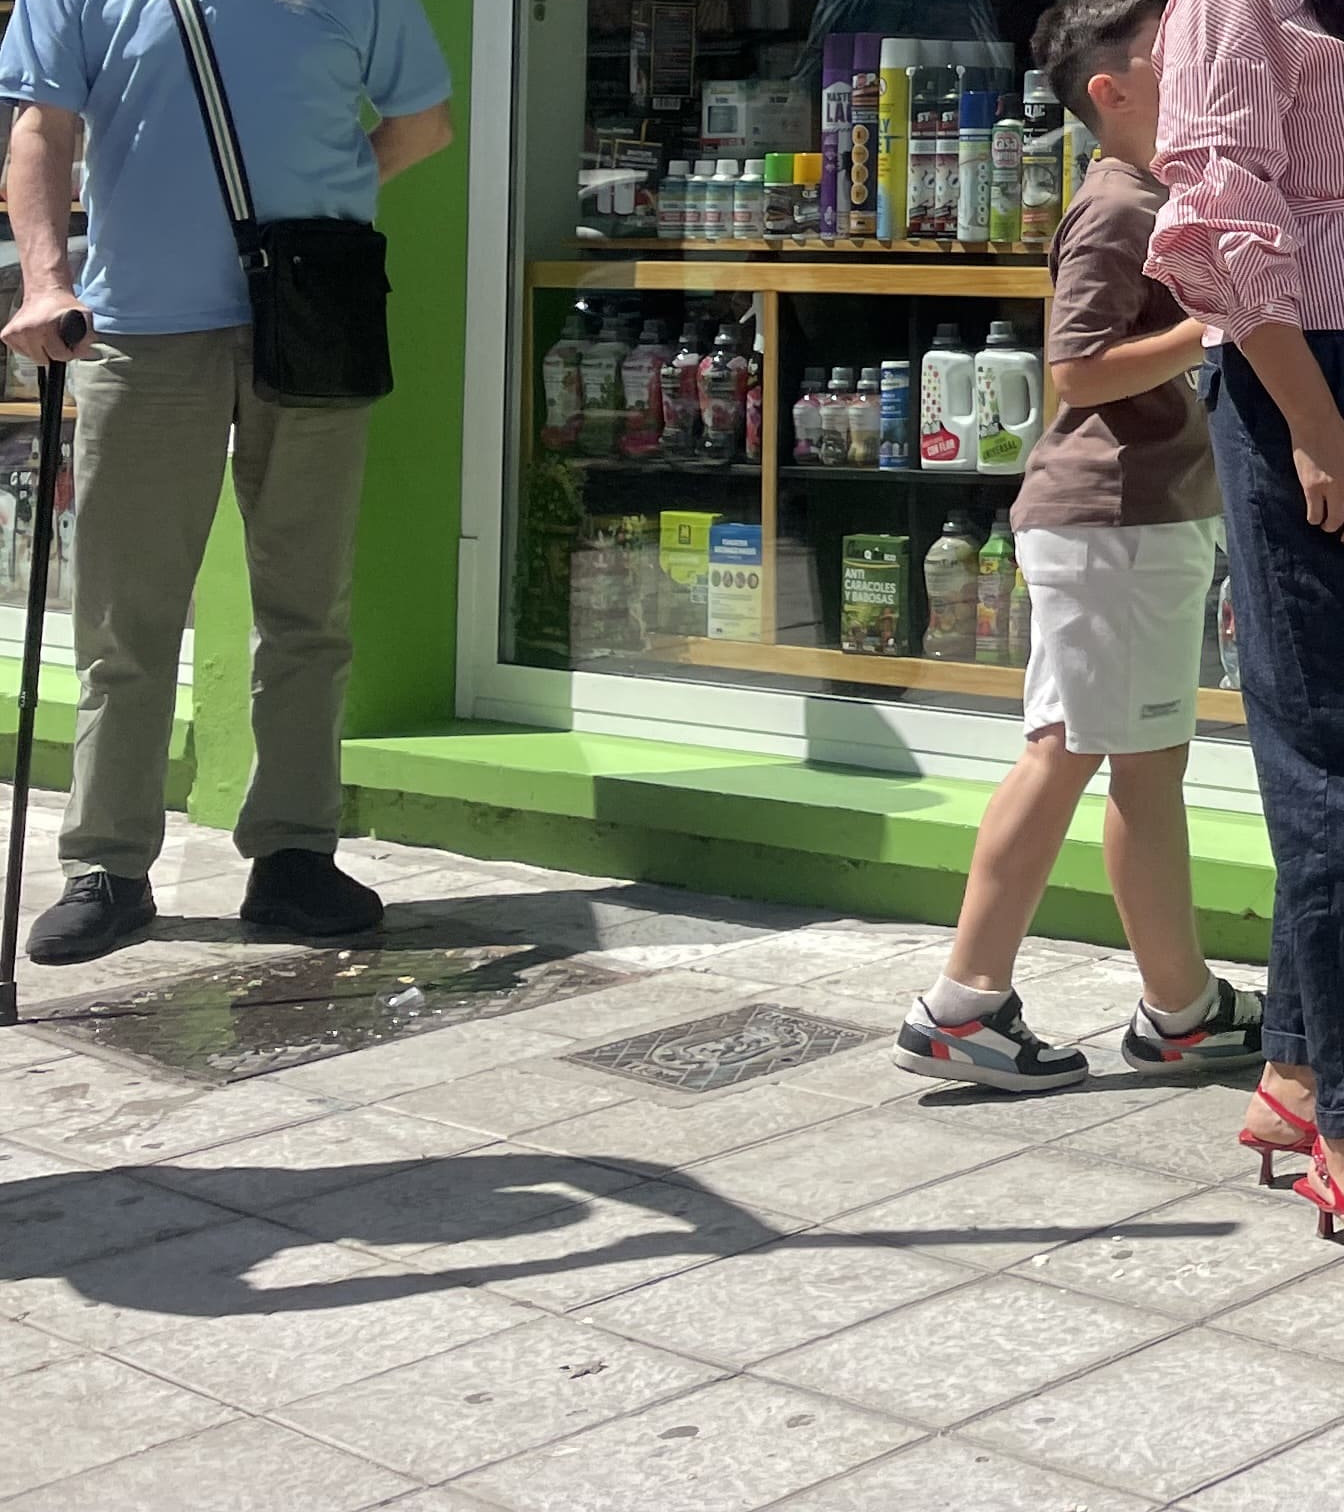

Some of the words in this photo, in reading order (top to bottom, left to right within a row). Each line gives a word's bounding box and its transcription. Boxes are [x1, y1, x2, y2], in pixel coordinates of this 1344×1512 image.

[845, 568, 865, 579] ANTI
[844, 579, 897, 594] CARACOLES
[844, 590, 851, 601] Y
[852, 591, 894, 605] BABOSAS
